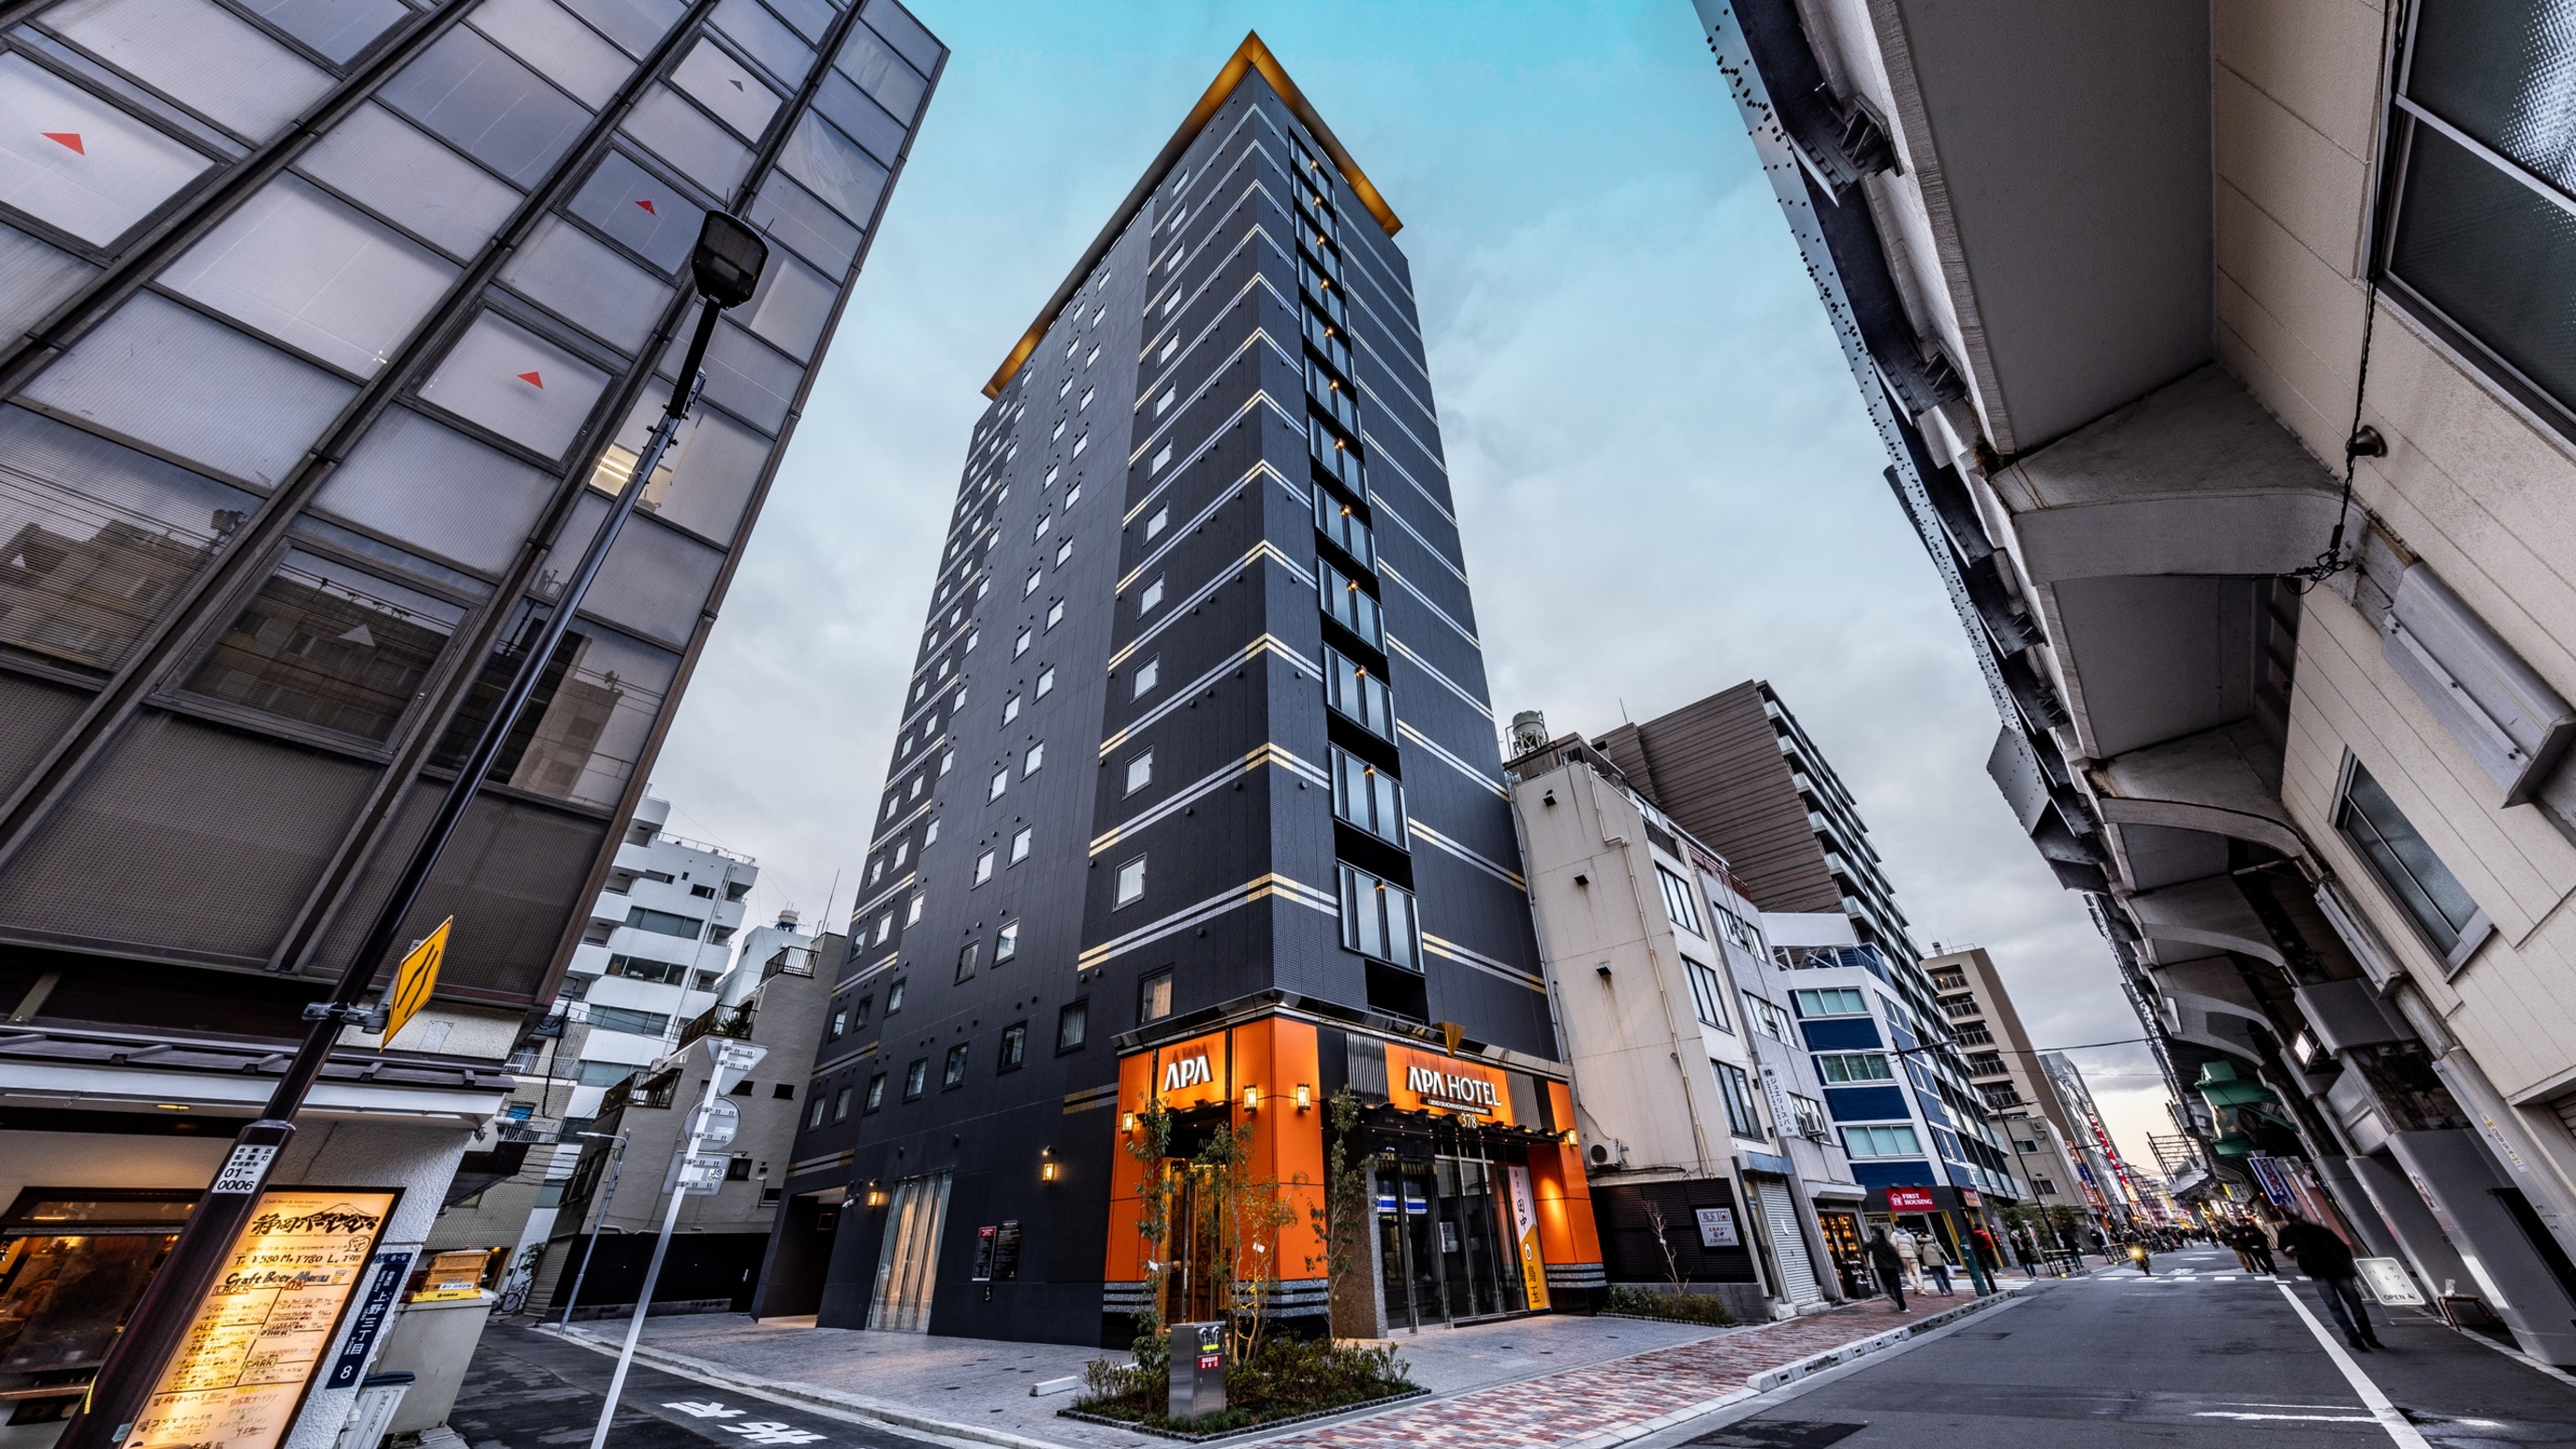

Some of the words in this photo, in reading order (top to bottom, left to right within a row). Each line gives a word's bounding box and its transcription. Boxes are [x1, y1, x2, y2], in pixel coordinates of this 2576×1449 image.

[1164, 1055, 1210, 1091] APA
[1408, 1065, 1446, 1097] APA
[1446, 1074, 1502, 1106] HOTEL
[1461, 1112, 1477, 1129] 378
[217, 1179, 255, 1191] 0006
[225, 1272, 262, 1285] Craft
[262, 1271, 292, 1283] Beer
[291, 1269, 330, 1282] Menu
[194, 1323, 217, 1331] ALE
[244, 1360, 274, 1368] DARK
[340, 1365, 352, 1379] 8
